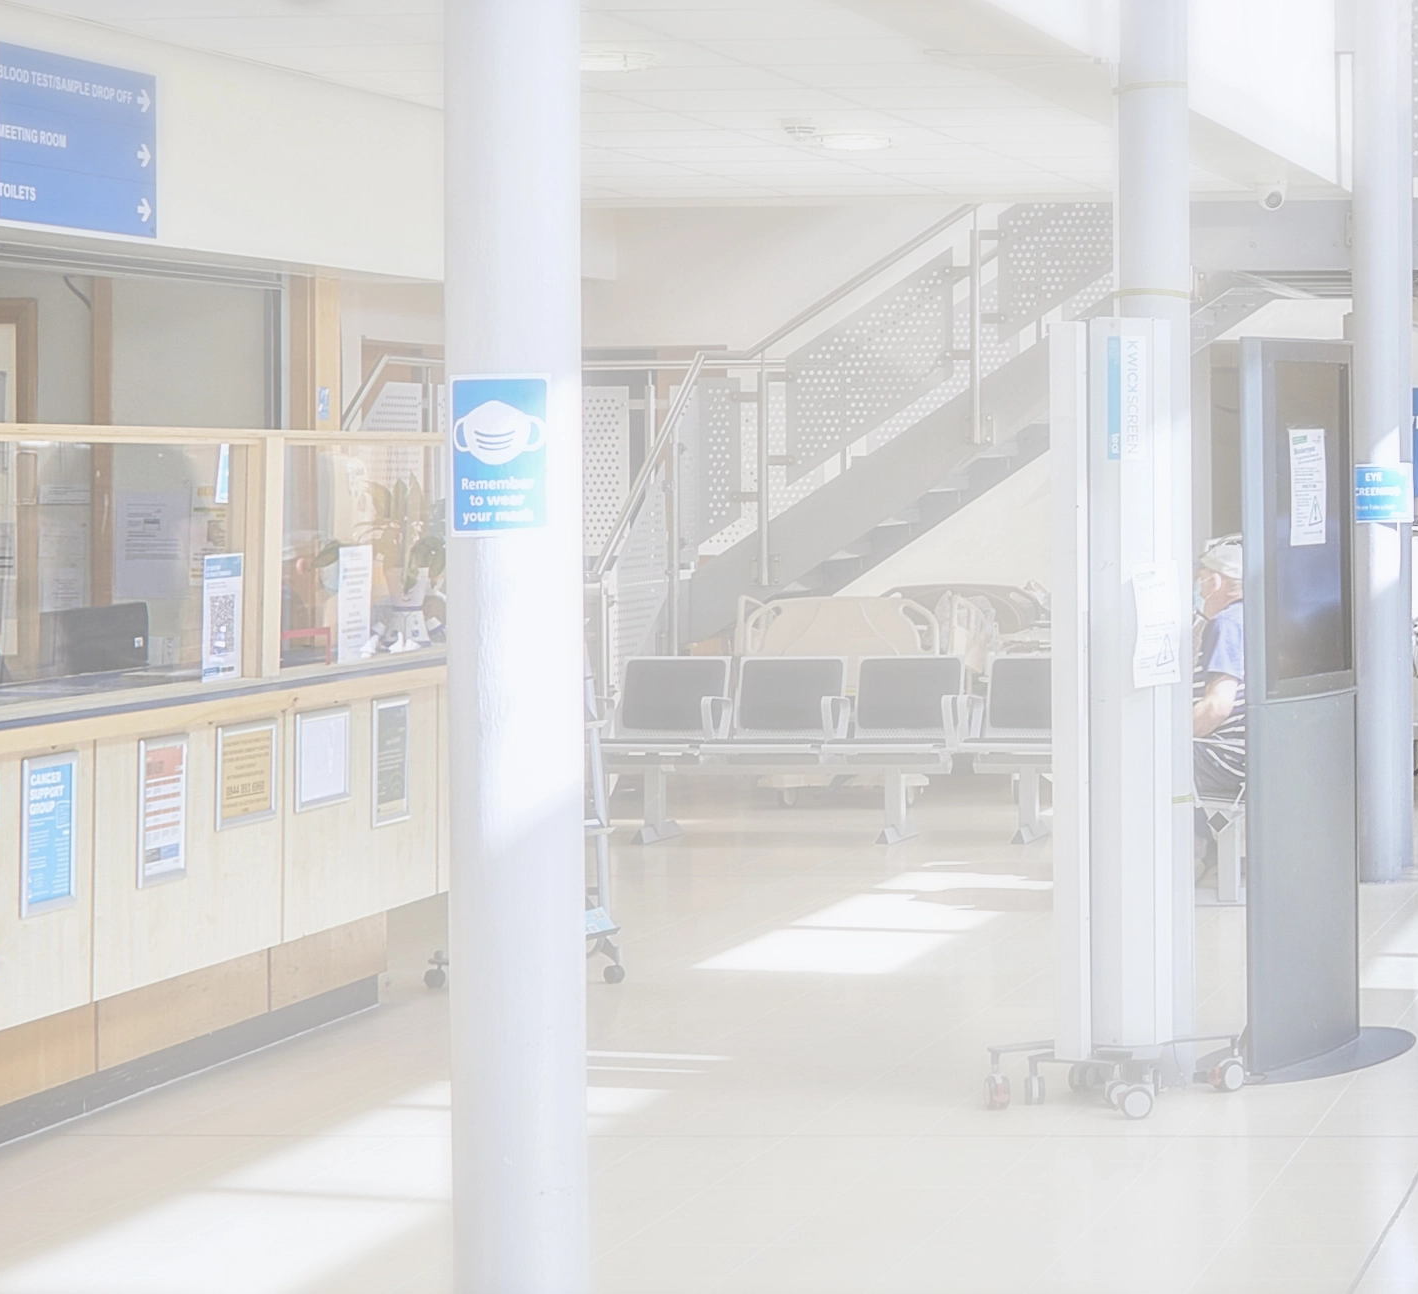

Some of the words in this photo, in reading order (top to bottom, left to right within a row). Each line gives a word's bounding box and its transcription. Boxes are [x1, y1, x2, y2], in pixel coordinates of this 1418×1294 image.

[31, 71, 91, 97] TEST/SAMPLE
[92, 83, 115, 102] DROP
[116, 90, 133, 105] OFF
[39, 130, 67, 148] ROOM
[461, 476, 535, 491] Remember
[469, 494, 484, 507] to
[486, 494, 526, 507] wear
[462, 511, 493, 526] your
[30, 770, 62, 786] CANCER
[30, 785, 64, 800] SUPPORT
[29, 800, 56, 815] GROUP
